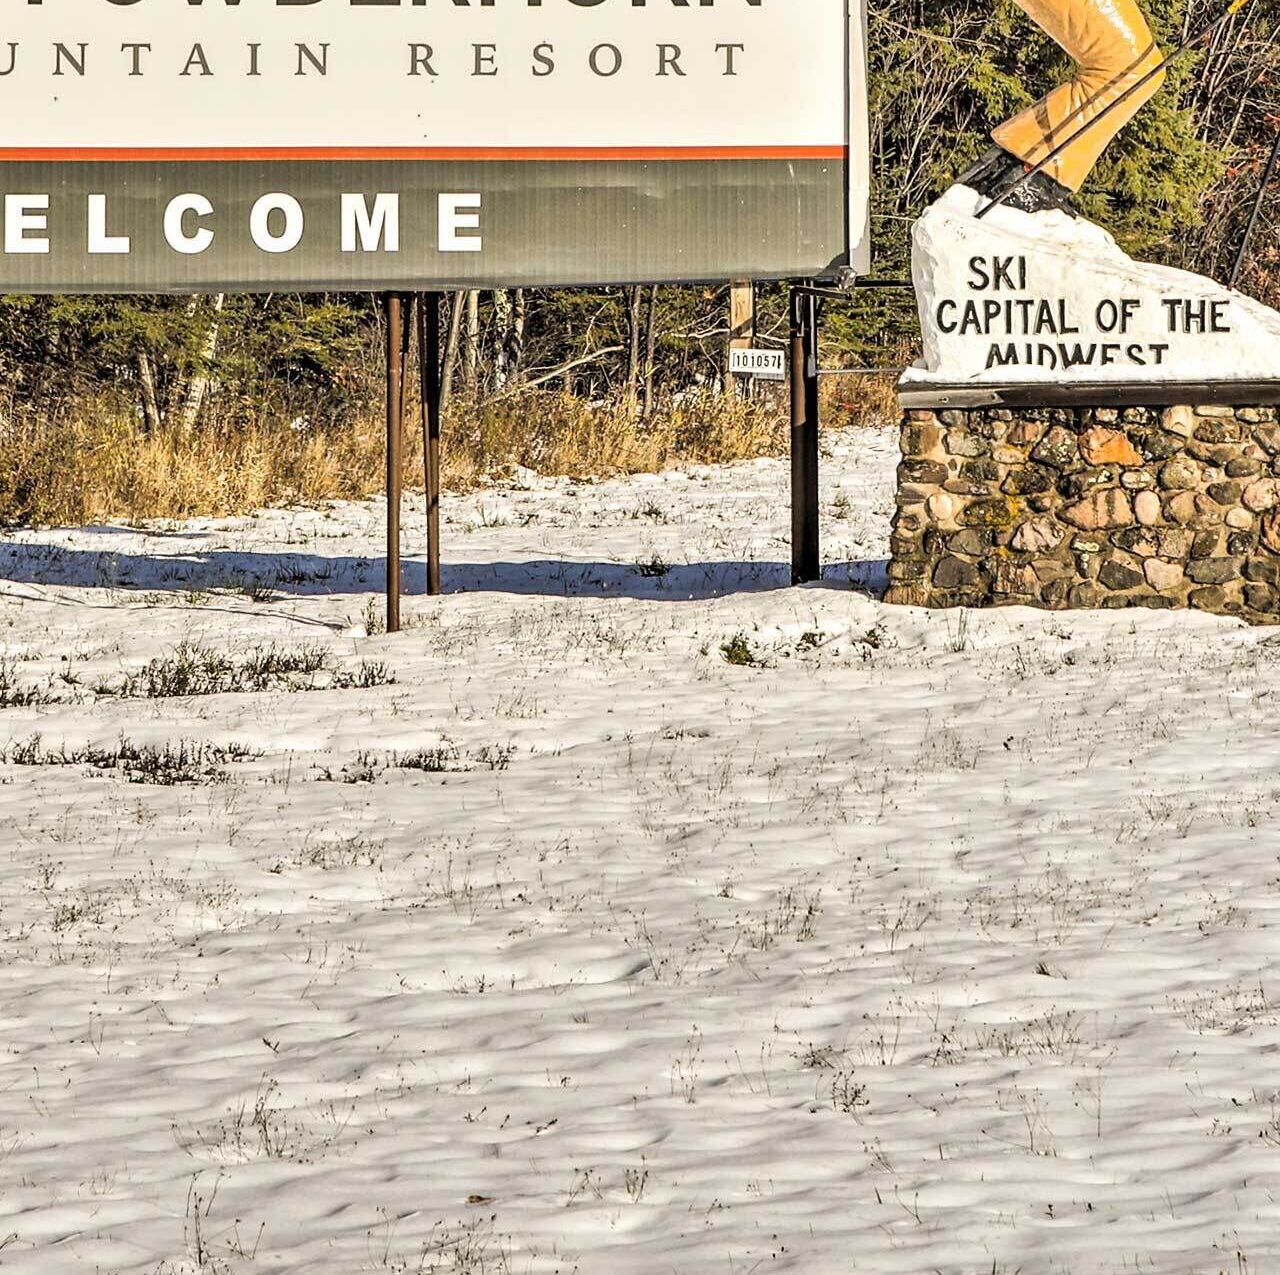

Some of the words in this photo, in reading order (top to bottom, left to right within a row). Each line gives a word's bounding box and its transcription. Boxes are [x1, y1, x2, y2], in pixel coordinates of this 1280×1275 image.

[407, 42, 745, 78] RESORT
[967, 256, 1026, 292] SKI
[936, 298, 1080, 336] CAPITAL
[1094, 299, 1141, 335] OF
[1161, 298, 1231, 335] THE
